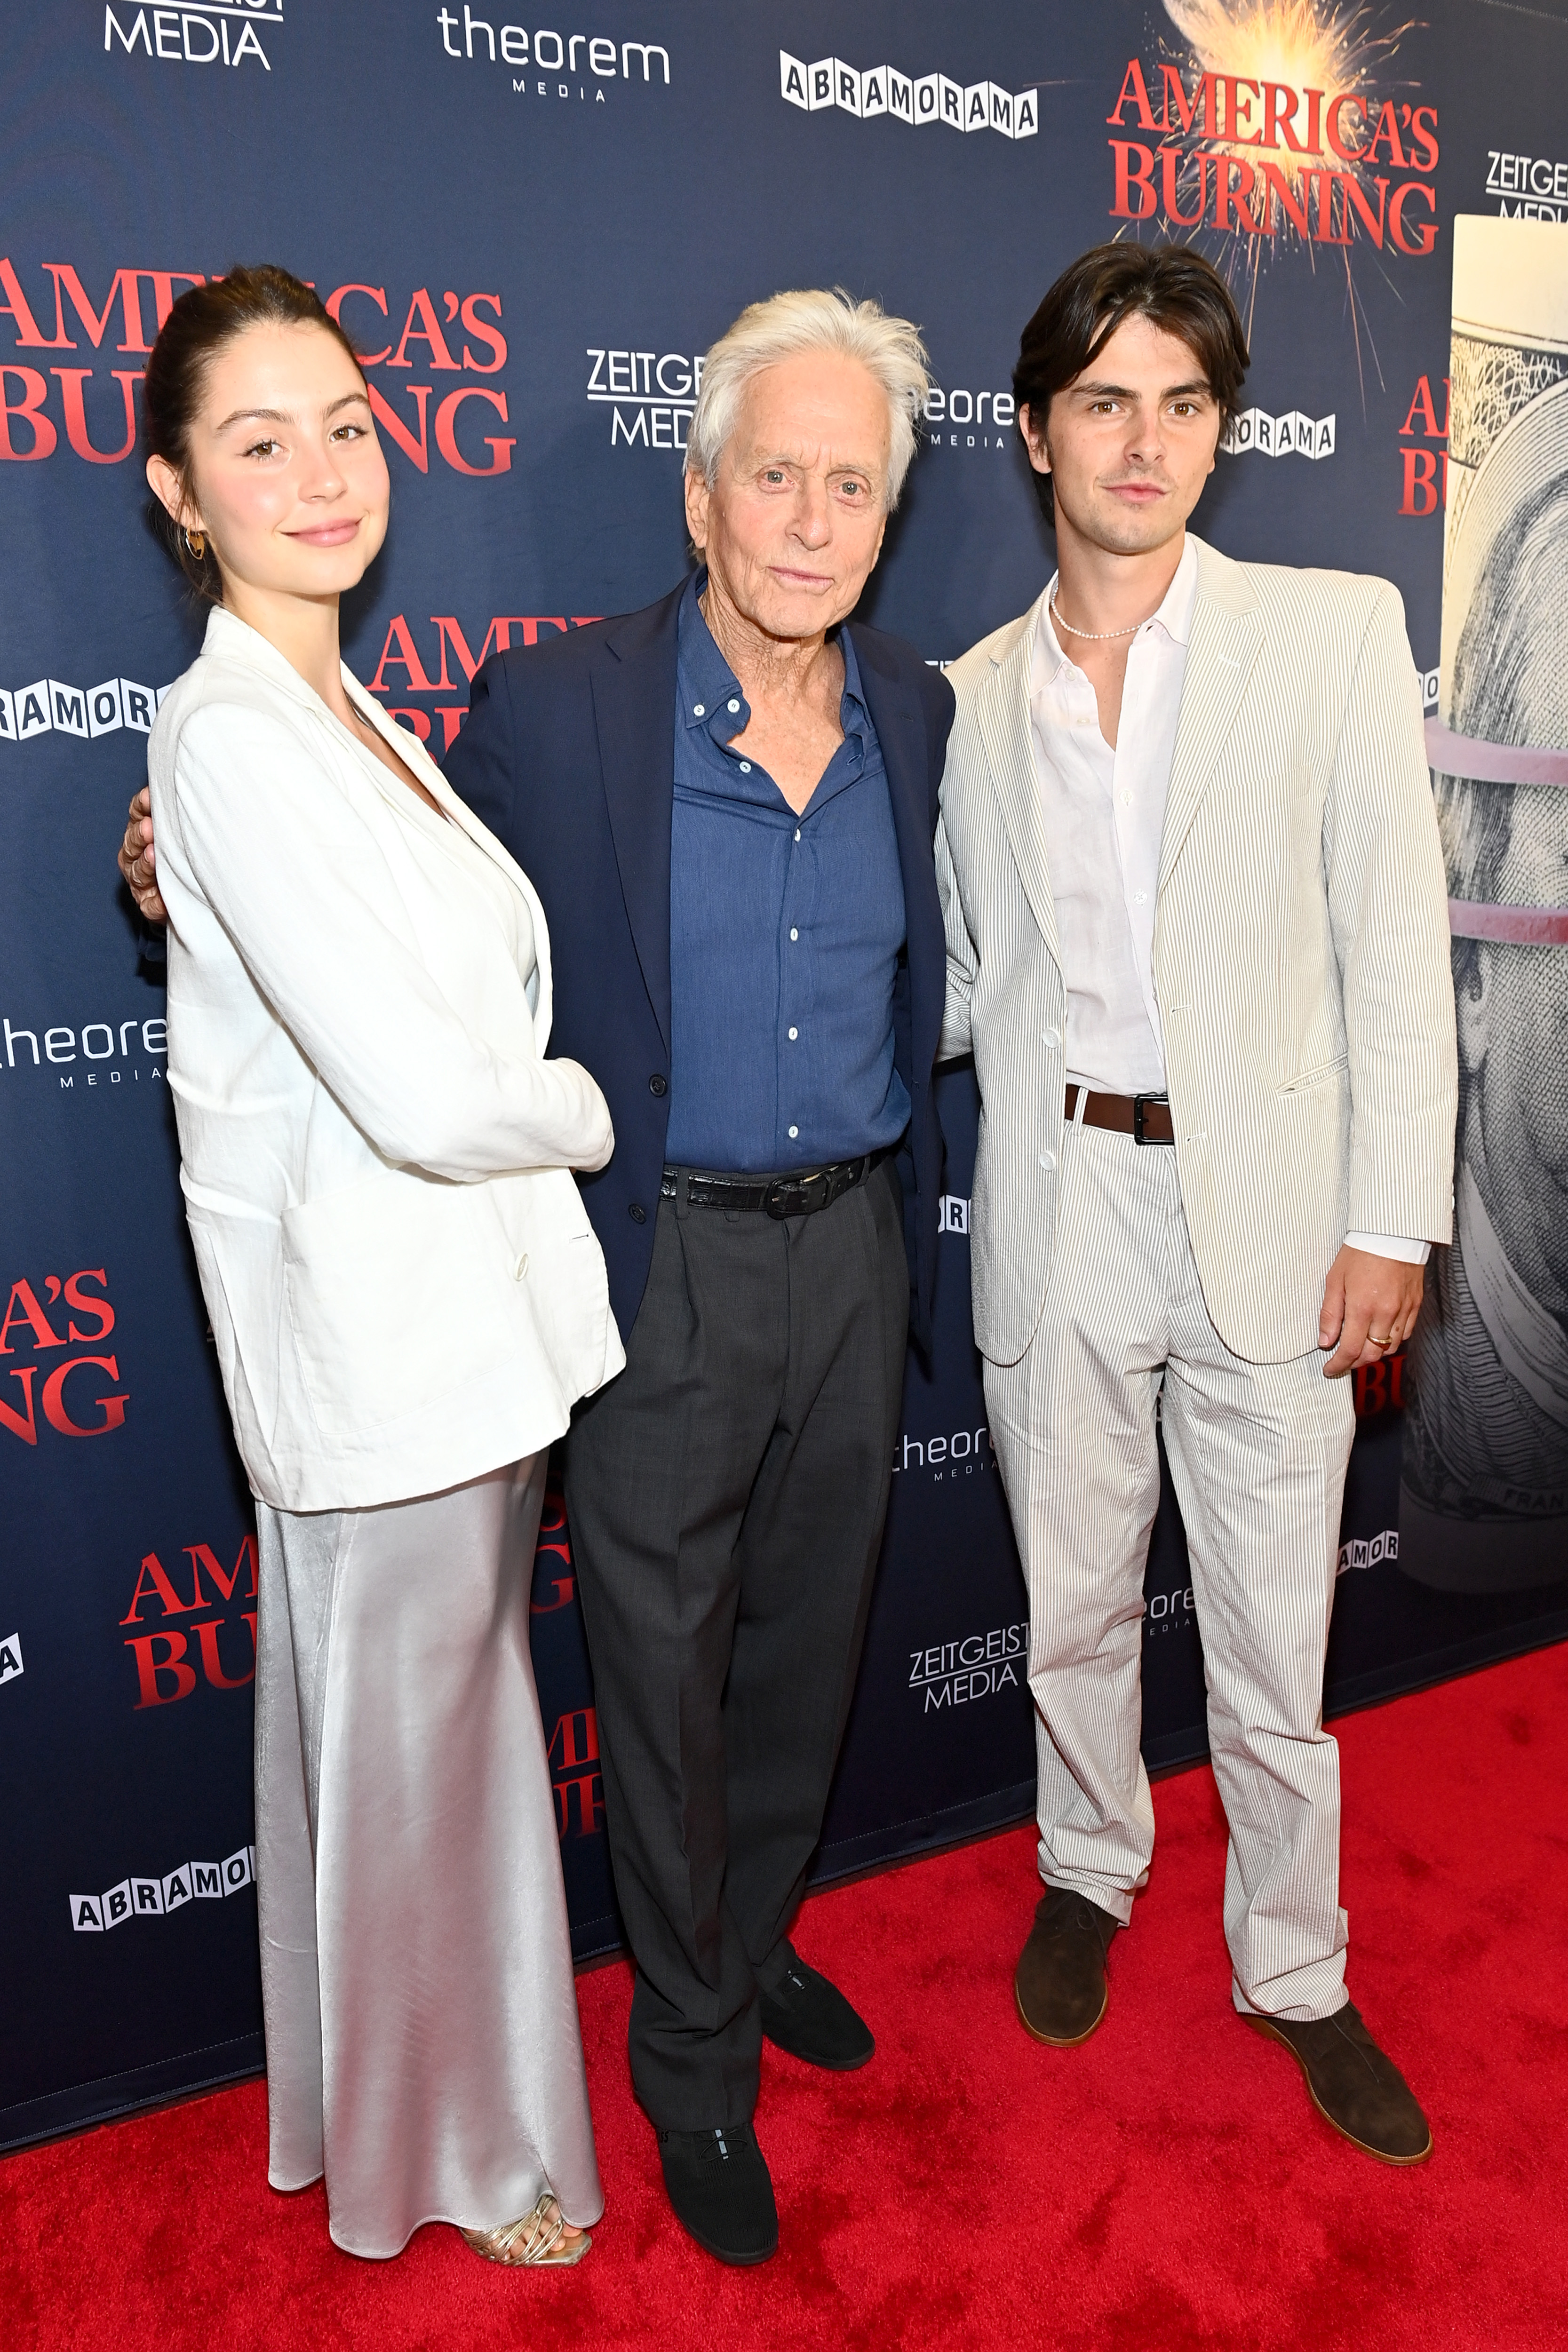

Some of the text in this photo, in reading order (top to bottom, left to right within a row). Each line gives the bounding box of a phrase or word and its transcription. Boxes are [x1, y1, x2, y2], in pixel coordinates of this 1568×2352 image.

[104, 4, 271, 71] MEDIA
[436, 4, 670, 85] theorem
[512, 79, 605, 103] MEDIA
[784, 61, 1036, 134] ABRAMORAMA
[1106, 57, 1440, 174] AMERICA'S
[1108, 139, 1440, 256] BURNING
[1486, 151, 1568, 199] ZEITGE
[0, 365, 517, 476] BUNG
[612, 405, 693, 449] MED
[923, 388, 1015, 426] eore
[931, 434, 1004, 449] MEDIA
[0, 1018, 167, 1069] heore
[60, 1067, 161, 1089] MEDIA
[892, 1427, 995, 1472] heor
[934, 1460, 998, 1482] MEDIA
[1149, 1618, 1190, 1636] EDIA
[924, 1662, 1019, 1714] MEDIA
